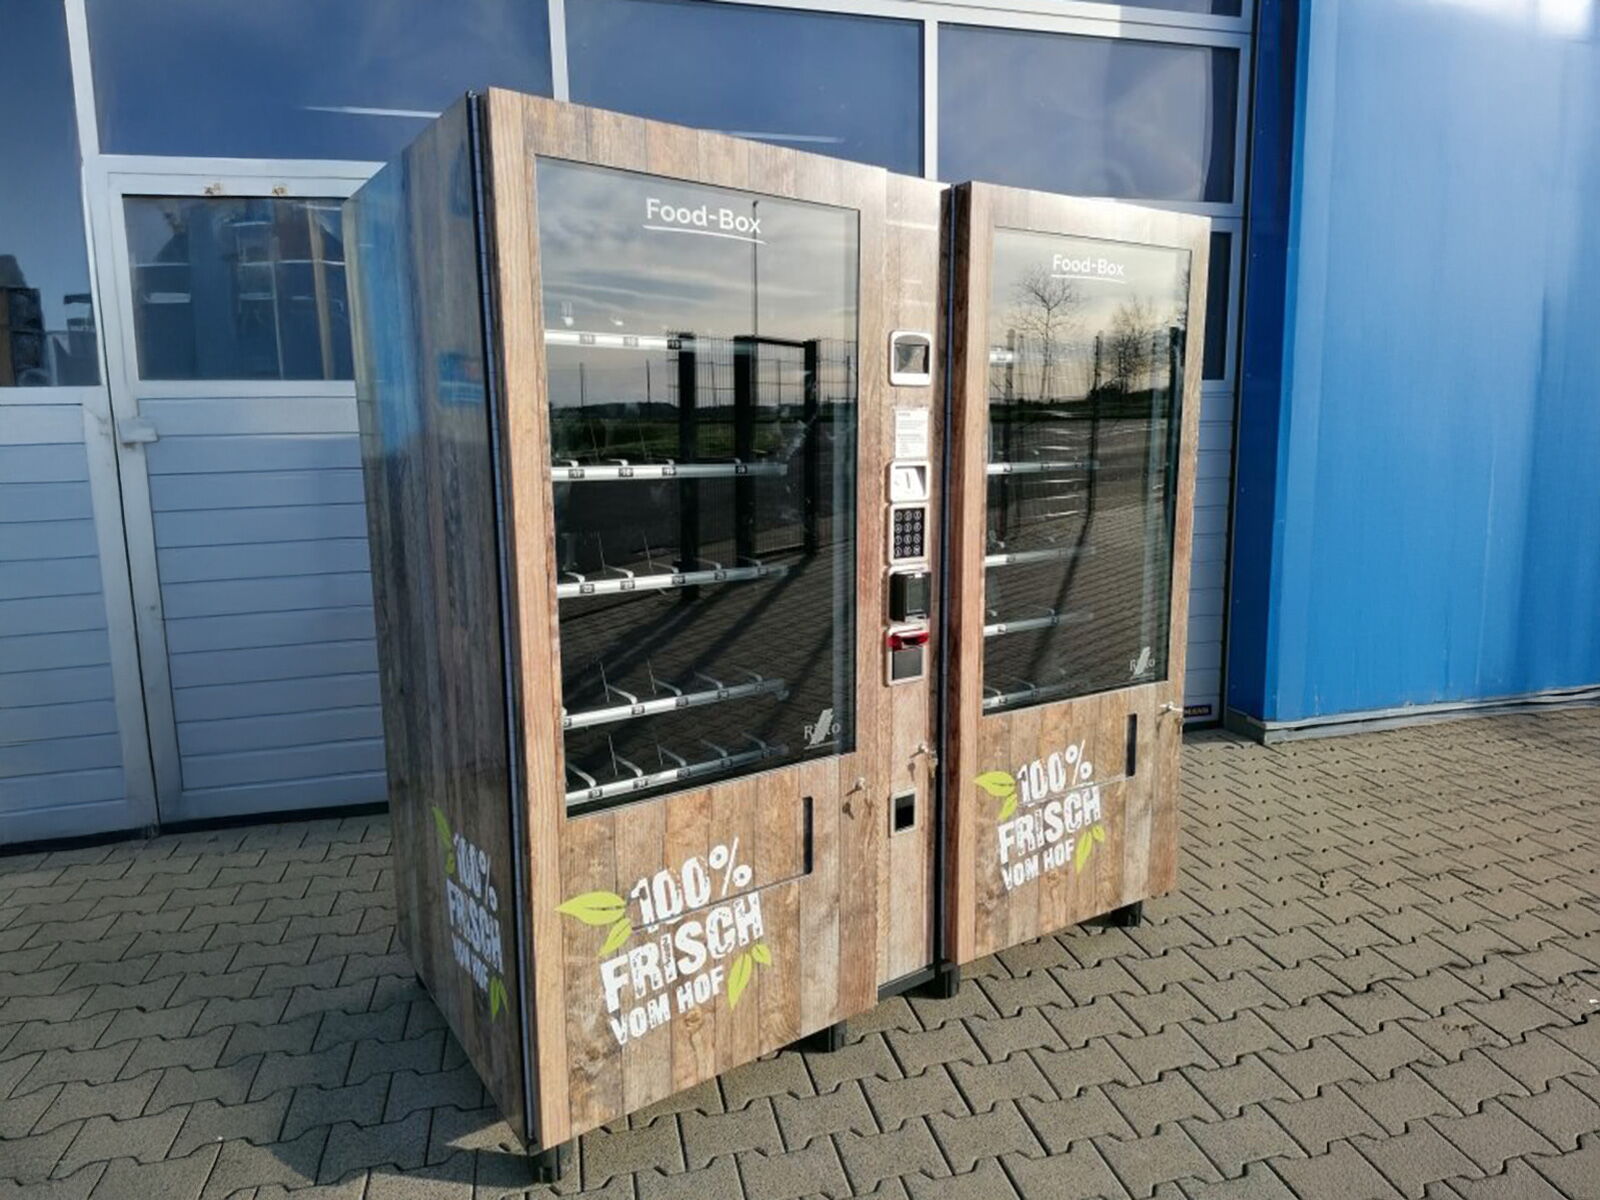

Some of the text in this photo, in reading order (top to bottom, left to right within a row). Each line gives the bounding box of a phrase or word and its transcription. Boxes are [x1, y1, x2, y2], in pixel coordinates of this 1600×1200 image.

[646, 197, 761, 233] Food-Box
[1053, 254, 1125, 276] Food-Box
[1017, 739, 1093, 804] 100%
[998, 786, 1101, 864] FRISCH
[630, 836, 752, 933] 100%
[1002, 838, 1075, 891] VOM HOF
[600, 891, 764, 1013] FRISCH
[610, 965, 725, 1045] VOM HOF
